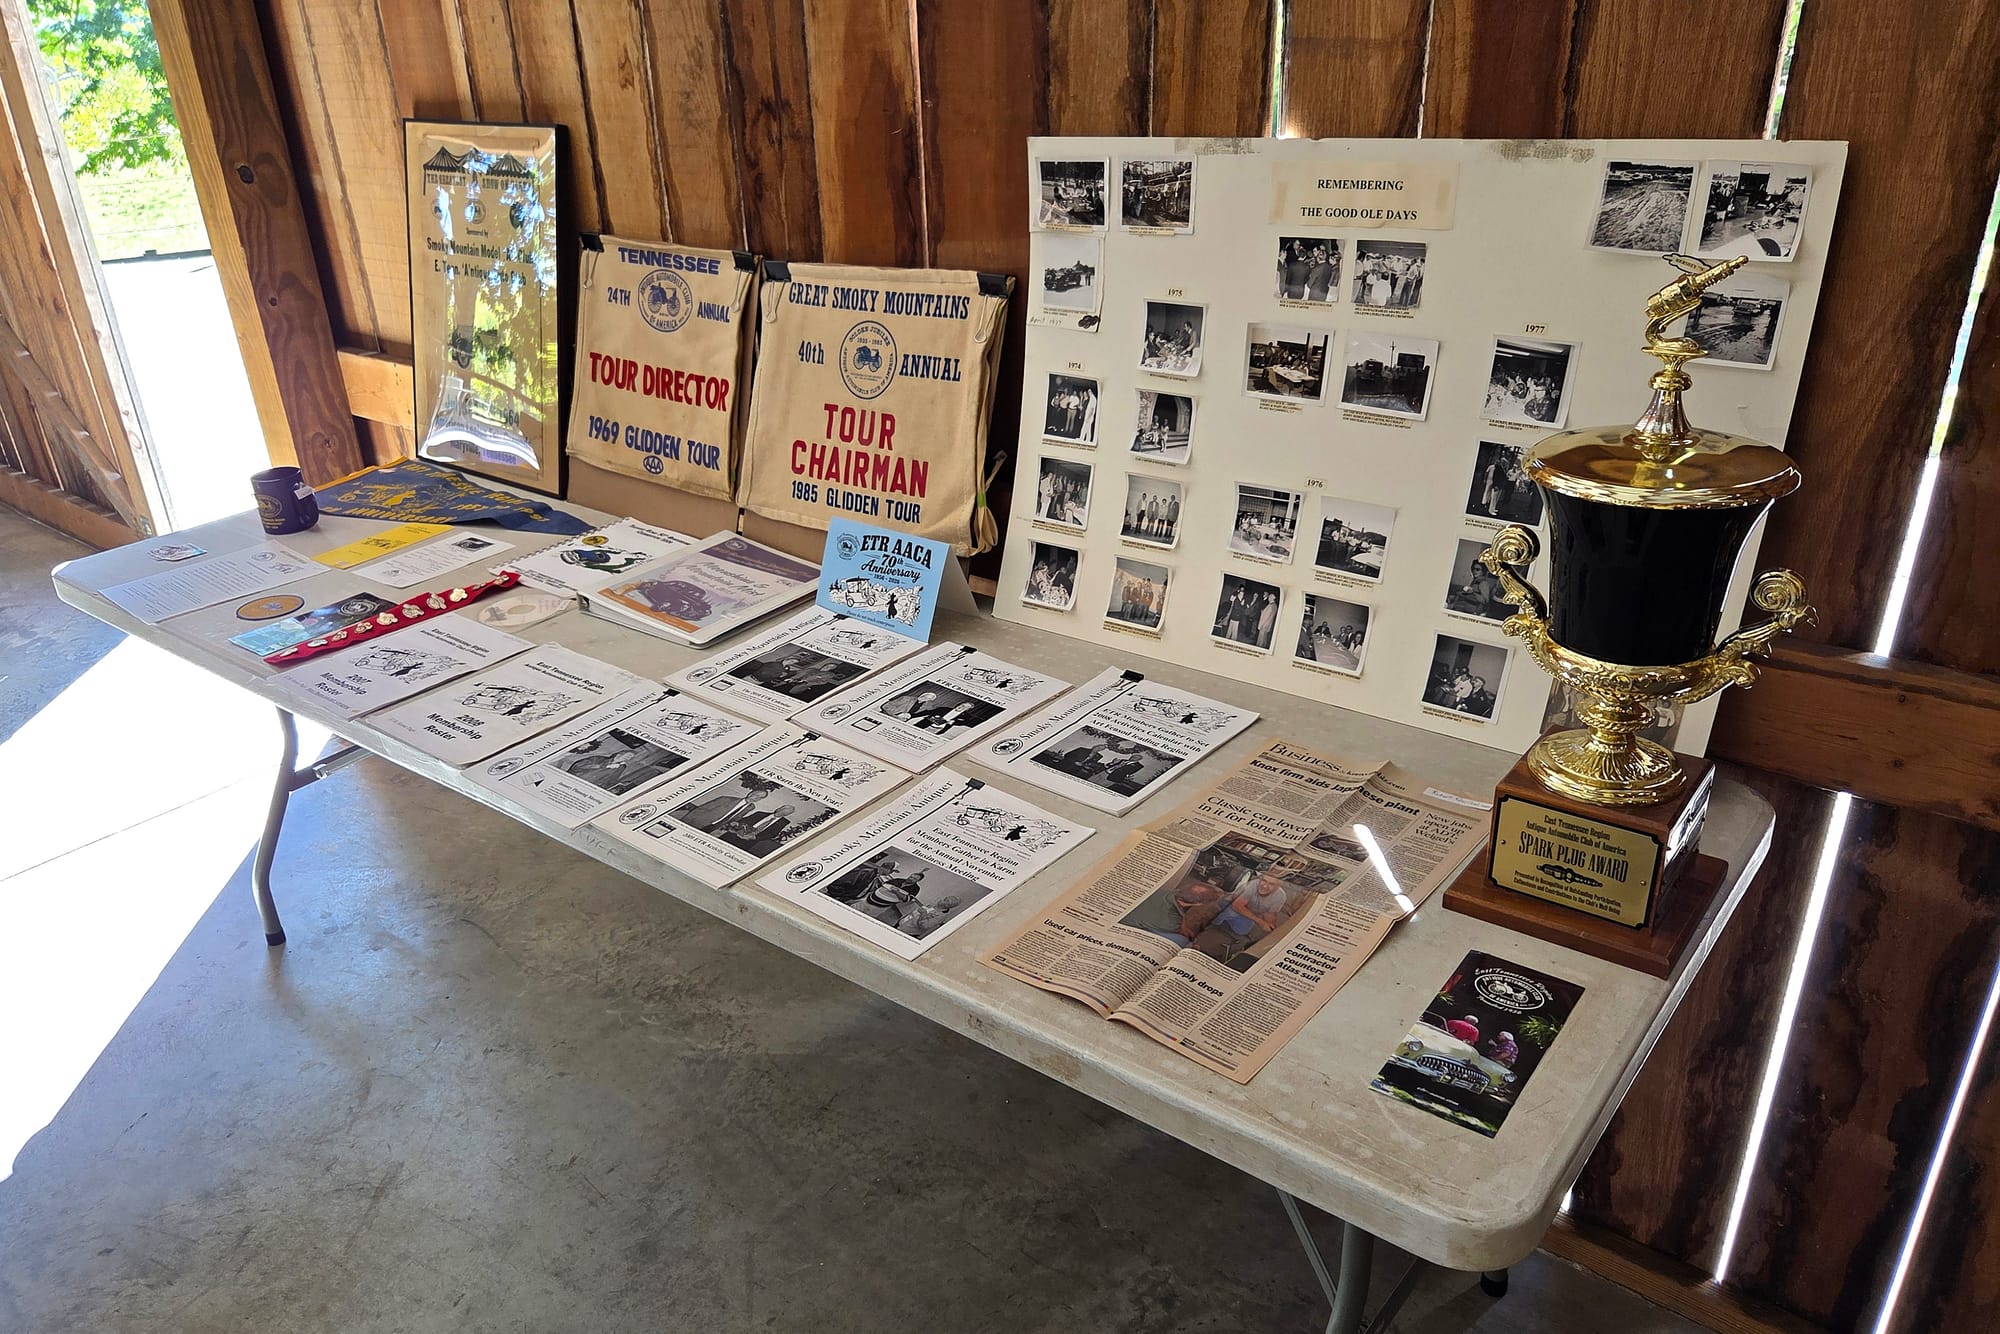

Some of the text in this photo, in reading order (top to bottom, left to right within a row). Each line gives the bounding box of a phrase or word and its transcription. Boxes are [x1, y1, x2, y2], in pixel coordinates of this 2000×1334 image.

[1317, 179, 1404, 191] REMEMBERING
[1300, 206, 1418, 220] THE GOOD OLE DAYS
[449, 240, 480, 257] Mountain
[618, 247, 720, 275] TENNESSEE
[607, 286, 631, 306] 24TH
[788, 282, 970, 320] GREAT SMOKY MOUNTAINS
[1168, 288, 1183, 297] 1975
[697, 301, 730, 323] ANNUAL
[1525, 324, 1545, 335] 1977
[798, 340, 825, 365] 40th
[1067, 362, 1081, 370] 1974
[589, 351, 730, 412] TOUR DIRECTOR
[899, 354, 961, 382] ANNUAL
[824, 403, 896, 451] TOUR
[588, 415, 720, 471] 1969 GLIDDEN TOUR
[791, 439, 929, 499] CHAIRMAN
[1306, 479, 1323, 488] 1976
[791, 480, 921, 524] 1985 GLIDDEN TOUR
[860, 535, 932, 569] ETR AACA
[881, 554, 904, 568] 70th
[861, 559, 921, 583] Anniversary
[715, 650, 749, 667] Smoky
[750, 632, 789, 654] Mountain
[315, 682, 342, 695] Roster
[320, 672, 368, 695] Membership
[537, 661, 604, 689] East Tennessee Region
[424, 724, 456, 741] Roster
[427, 713, 483, 740] Membership
[456, 714, 485, 727] 2008
[1020, 699, 1091, 740] Smoky Mountain
[1103, 708, 1121, 717] ETR
[1122, 714, 1156, 729] Members
[1157, 726, 1185, 739] Gather
[1193, 739, 1210, 747] Set
[523, 739, 562, 757] Smoky
[563, 713, 614, 739] Mountain
[626, 726, 673, 750] ETR Christmas
[1112, 718, 1145, 733] Activities
[1147, 730, 1184, 746] Calendar
[1183, 743, 1202, 753] with
[1160, 743, 1189, 757] Region
[1270, 743, 1341, 771] Business
[656, 731, 791, 804] Smoky Mountain Antiquer
[757, 768, 845, 808] ETR Starts the New Year!
[1250, 759, 1279, 773] Knox
[1279, 768, 1305, 780] firm
[1305, 777, 1330, 789] aids
[1384, 800, 1419, 816] plant
[821, 781, 953, 864] Smoky Mountain Antiquer
[1198, 802, 1309, 841] in it for long haul
[1207, 796, 1251, 814] Classic
[1252, 812, 1275, 823] car
[1426, 812, 1473, 831] New jobs
[1424, 819, 1465, 836] open up
[1526, 821, 1547, 833] Antique
[1548, 827, 1579, 843] Automobile
[1580, 835, 1593, 847] Club
[1602, 842, 1627, 856] America
[1544, 815, 1610, 840] East Tennessee Region
[906, 837, 1005, 882] for the Annual November
[915, 829, 951, 848] Members
[952, 846, 982, 861] Gather
[990, 861, 1017, 876] Karns
[933, 827, 1019, 867] East Tennessee Region
[1518, 831, 1629, 884] SPARK PLUG AWARD
[912, 849, 980, 882] Business Meeting
[1044, 918, 1064, 931] Used
[1063, 927, 1078, 937] car
[1077, 932, 1104, 947] prices,
[1105, 941, 1139, 957] demand
[1168, 965, 1197, 982] supply
[1197, 979, 1225, 998] drops
[1283, 957, 1325, 976] counters
[1286, 949, 1336, 971] contractor
[1295, 943, 1341, 964] Electrical
[1275, 961, 1321, 984] Atlas suit
[1493, 968, 1534, 983] Tennessee
